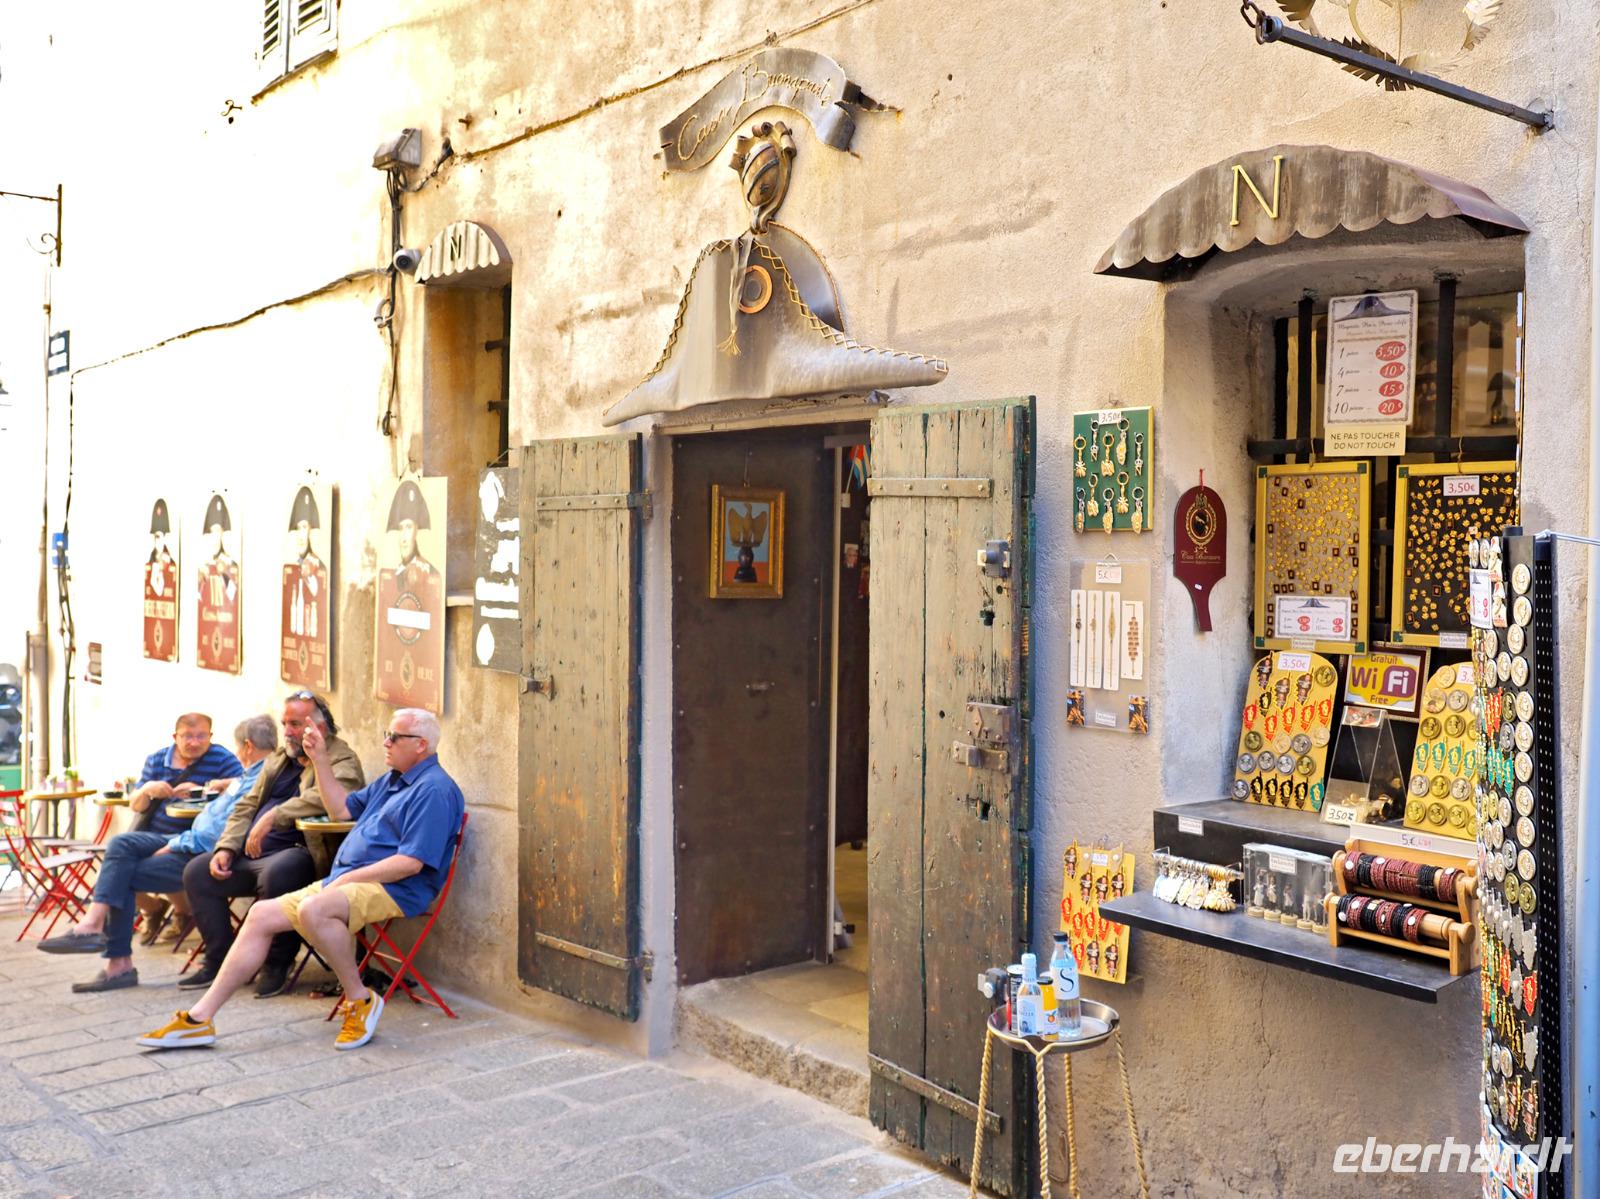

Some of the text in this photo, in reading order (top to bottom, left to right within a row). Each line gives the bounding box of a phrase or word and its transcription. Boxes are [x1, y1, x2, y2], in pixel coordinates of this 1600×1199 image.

[1229, 155, 1284, 226] N
[450, 234, 462, 261] N
[1343, 432, 1359, 440] PAS
[1361, 431, 1400, 440] TOUCHER
[1366, 441, 1396, 449] TOUCH
[1447, 482, 1475, 493] 3,50€
[1370, 654, 1398, 665] Gratuit
[1370, 695, 1389, 704] Free
[1060, 967, 1075, 992] S
